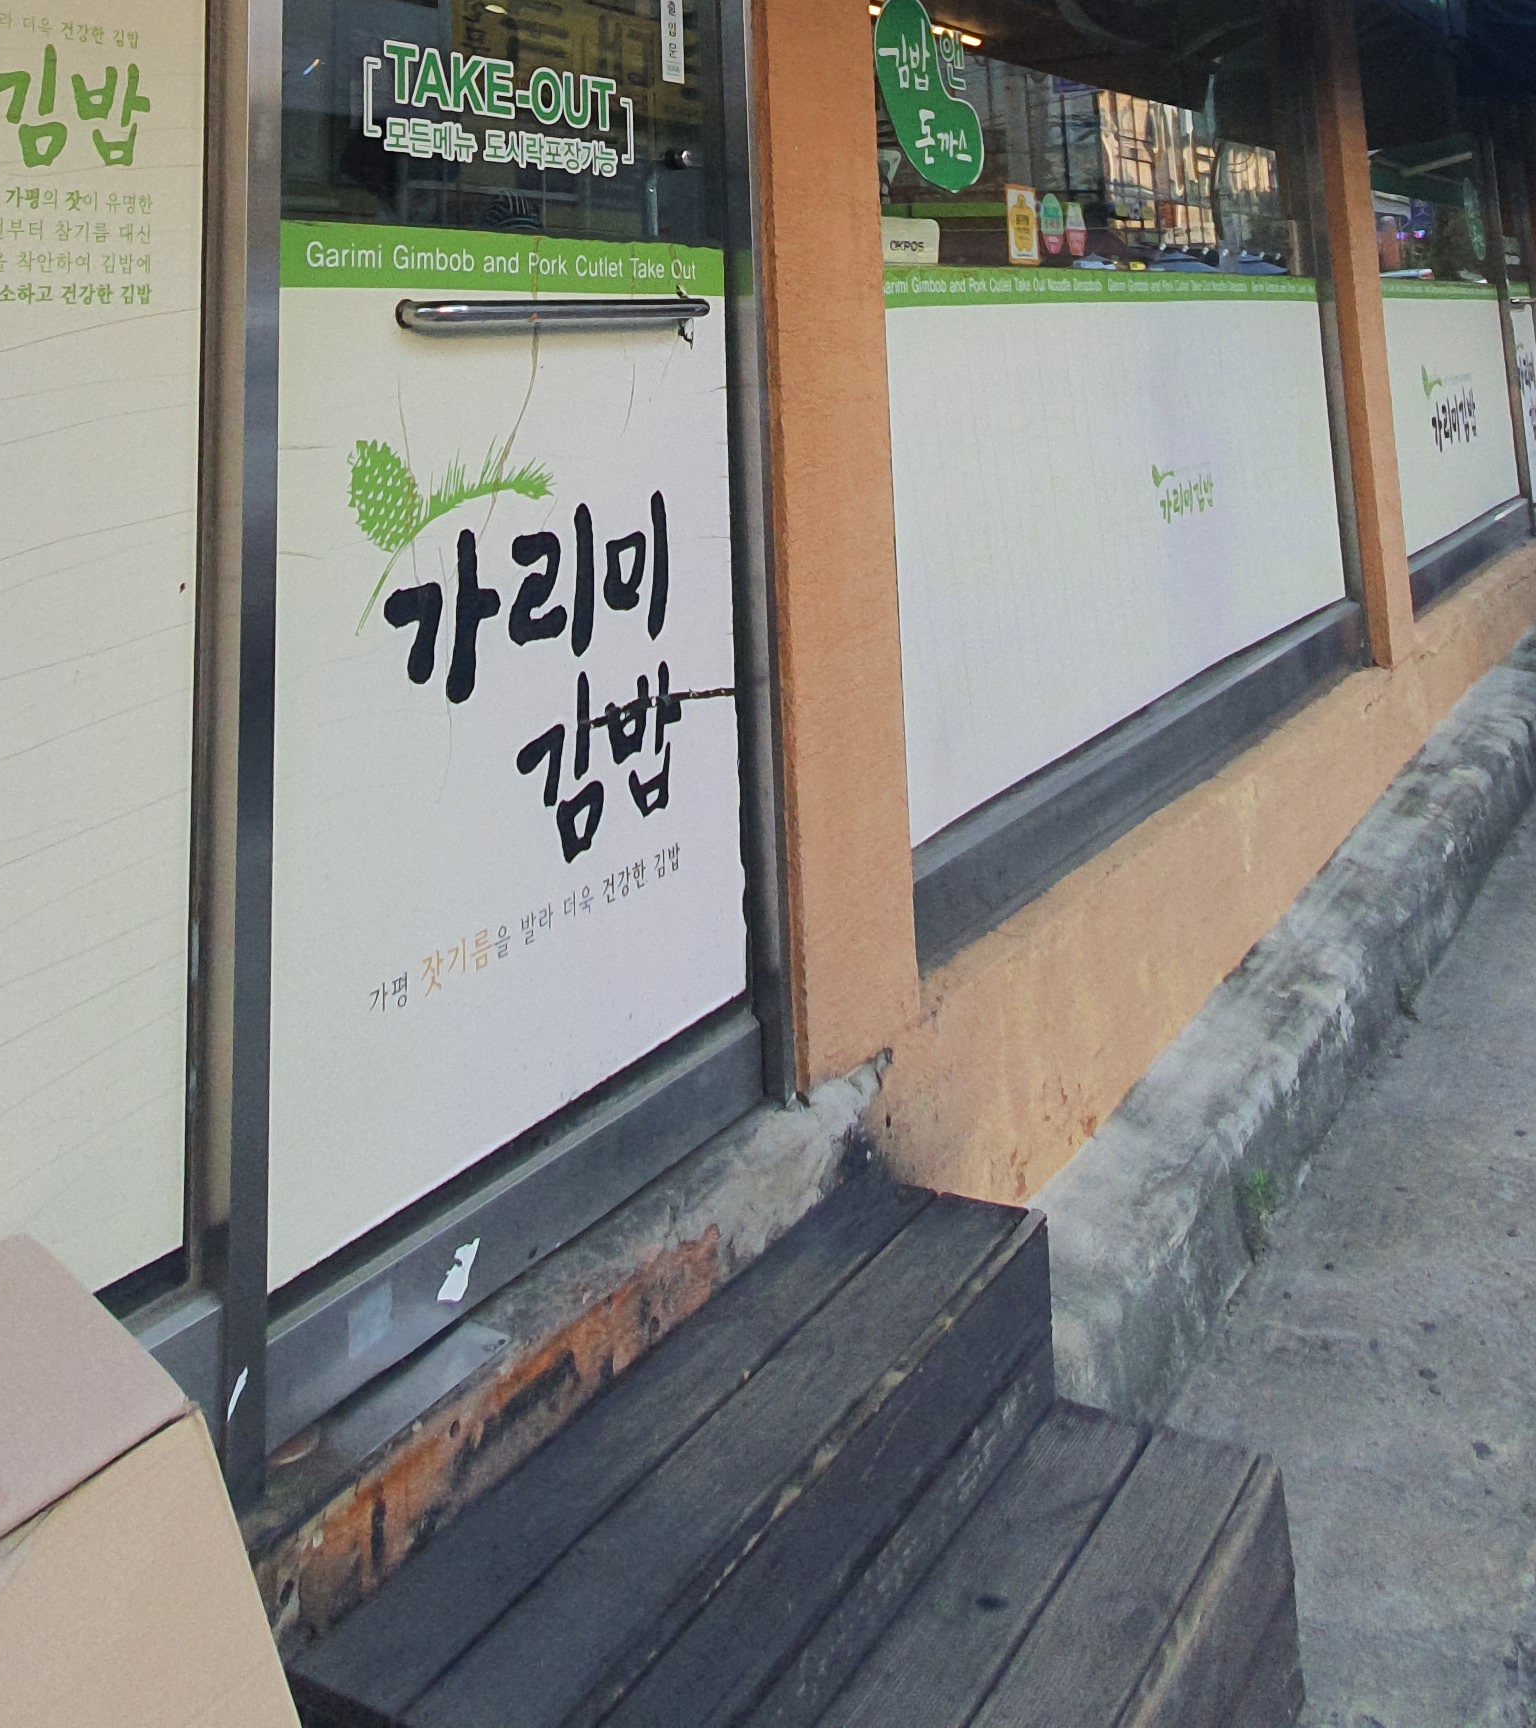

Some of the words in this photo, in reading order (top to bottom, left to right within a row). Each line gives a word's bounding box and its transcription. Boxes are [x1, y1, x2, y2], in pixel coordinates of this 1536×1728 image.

[60, 21, 105, 45] 건강한
[113, 29, 140, 50] 김밥
[878, 17, 931, 91] 김밥
[383, 39, 617, 132] TAKE-OUT
[384, 117, 478, 163] 모든메뉴
[483, 129, 619, 177] 도시락포장가능
[915, 108, 973, 165] 돈까스
[5, 186, 59, 210] 가평의
[64, 189, 99, 212] 잣이
[104, 191, 154, 215] 유명한
[54, 220, 110, 244] 참기름
[118, 222, 153, 245] 대신
[889, 239, 925, 252] OKPOS
[16, 250, 92, 274] 착안하여
[100, 251, 153, 275] 김밥에
[306, 240, 383, 270] Garimi
[392, 244, 475, 273] Gimbob
[483, 252, 520, 274] and
[527, 252, 569, 276] Pork
[575, 254, 624, 279] Cutlet
[631, 256, 665, 280] Take
[670, 258, 697, 281] Out
[60, 283, 114, 306] 건강한
[119, 283, 153, 306] 김밥
[884, 279, 908, 294] arimi
[949, 277, 966, 294] and
[383, 489, 670, 705] 가리미
[515, 660, 682, 864] 김밥
[368, 971, 409, 1013] 가평
[419, 924, 512, 999] 잣기름을
[519, 902, 554, 946] 발라
[563, 884, 595, 918] 더욱
[601, 858, 649, 904] 건강한
[653, 841, 681, 879] 김밥
